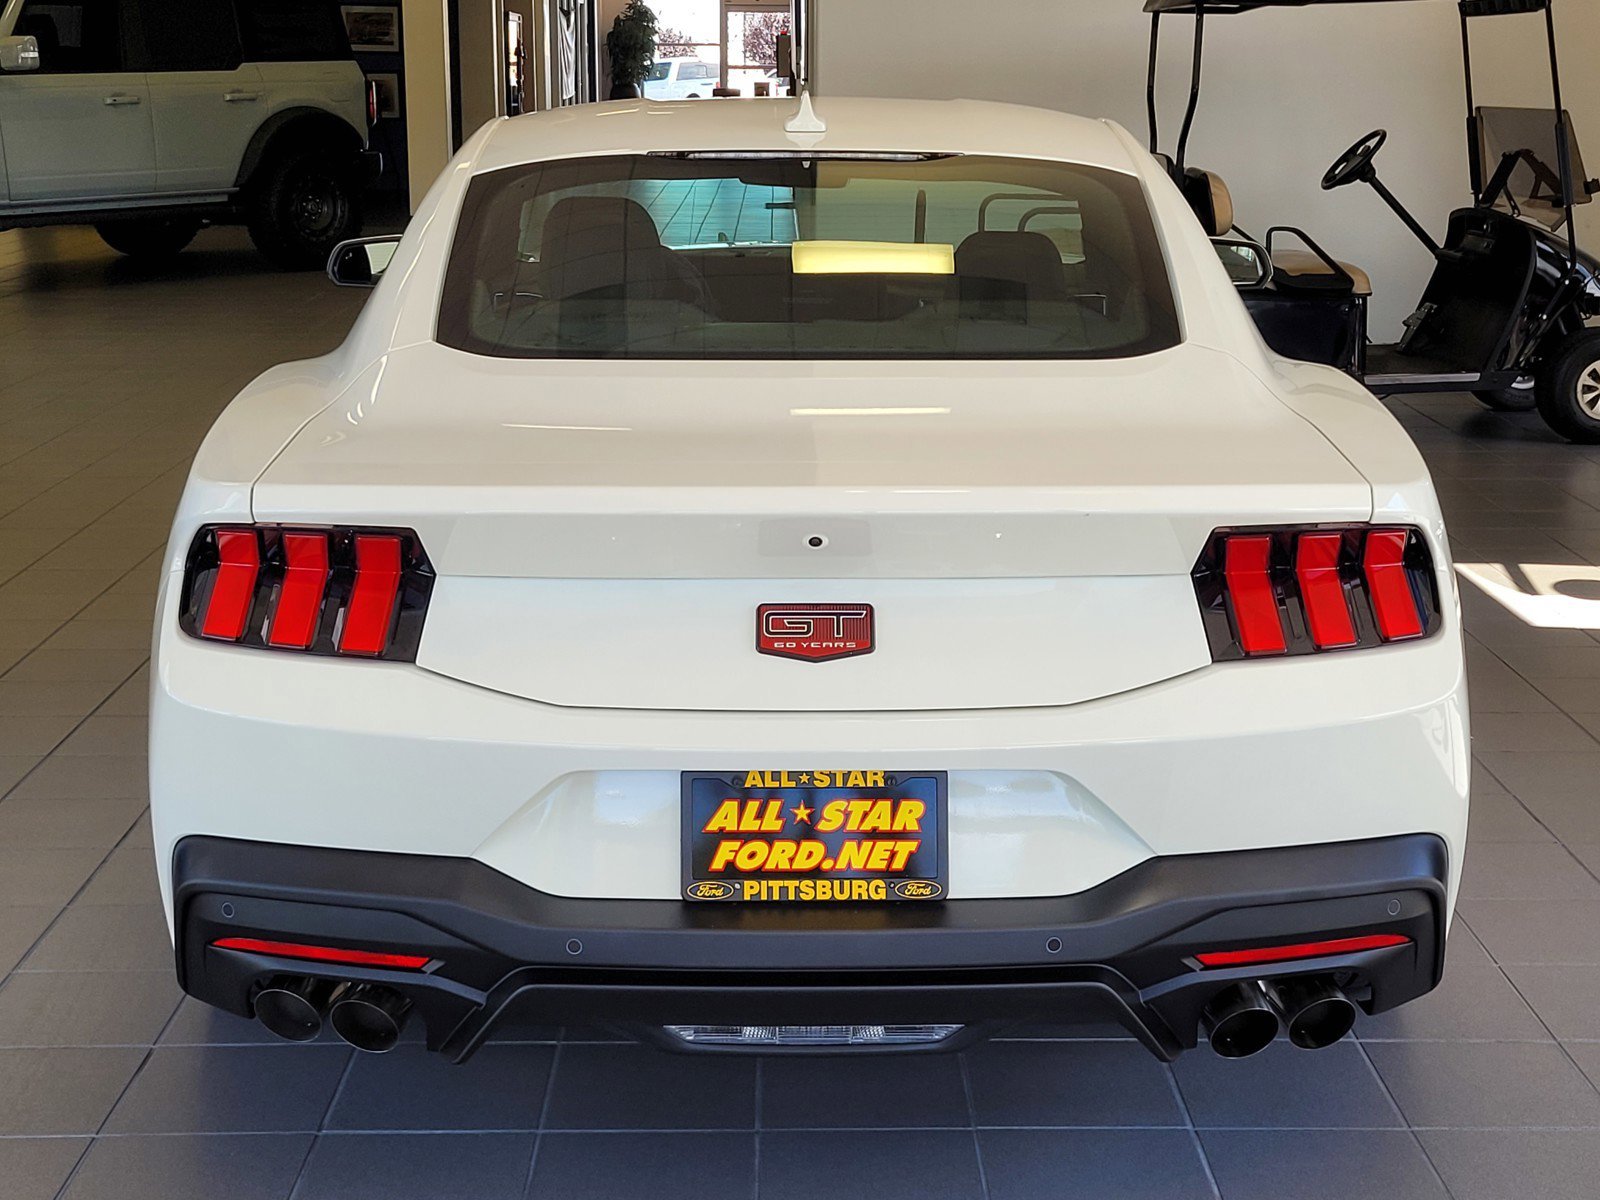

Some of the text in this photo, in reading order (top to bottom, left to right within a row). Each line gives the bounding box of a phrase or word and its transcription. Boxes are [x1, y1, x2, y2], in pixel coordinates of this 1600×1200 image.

[763, 610, 867, 638] GT
[744, 770, 885, 788] ALL STAR
[702, 798, 927, 833] ALL STAR
[708, 839, 922, 872] FORD.NET
[696, 885, 725, 897] Ford
[743, 880, 887, 900] PITTSBURG
[904, 884, 933, 896] Ford
